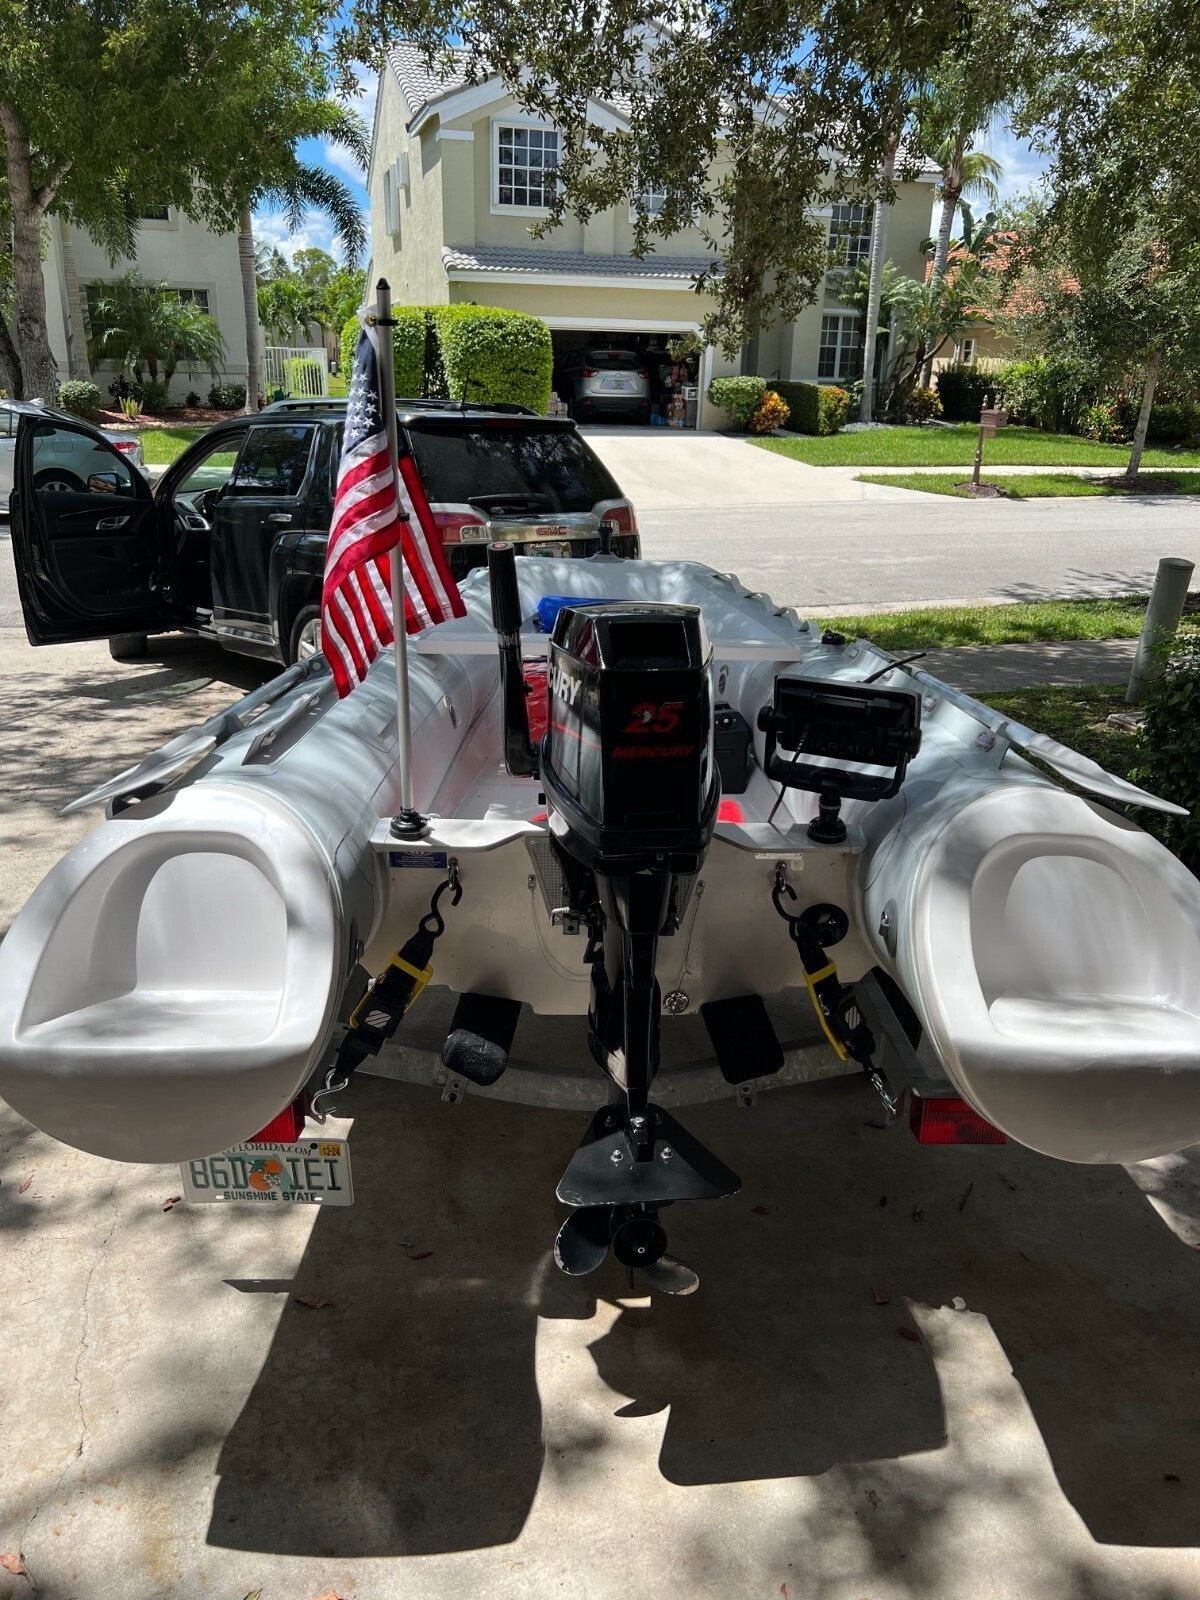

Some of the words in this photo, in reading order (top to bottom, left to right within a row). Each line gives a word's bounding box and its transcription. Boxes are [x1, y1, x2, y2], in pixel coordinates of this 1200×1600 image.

[536, 526, 567, 536] GMC
[624, 702, 684, 733] 25
[611, 745, 694, 758] MERCURY
[223, 1190, 278, 1201] SUNSHINE
[282, 1191, 317, 1201] STATE
